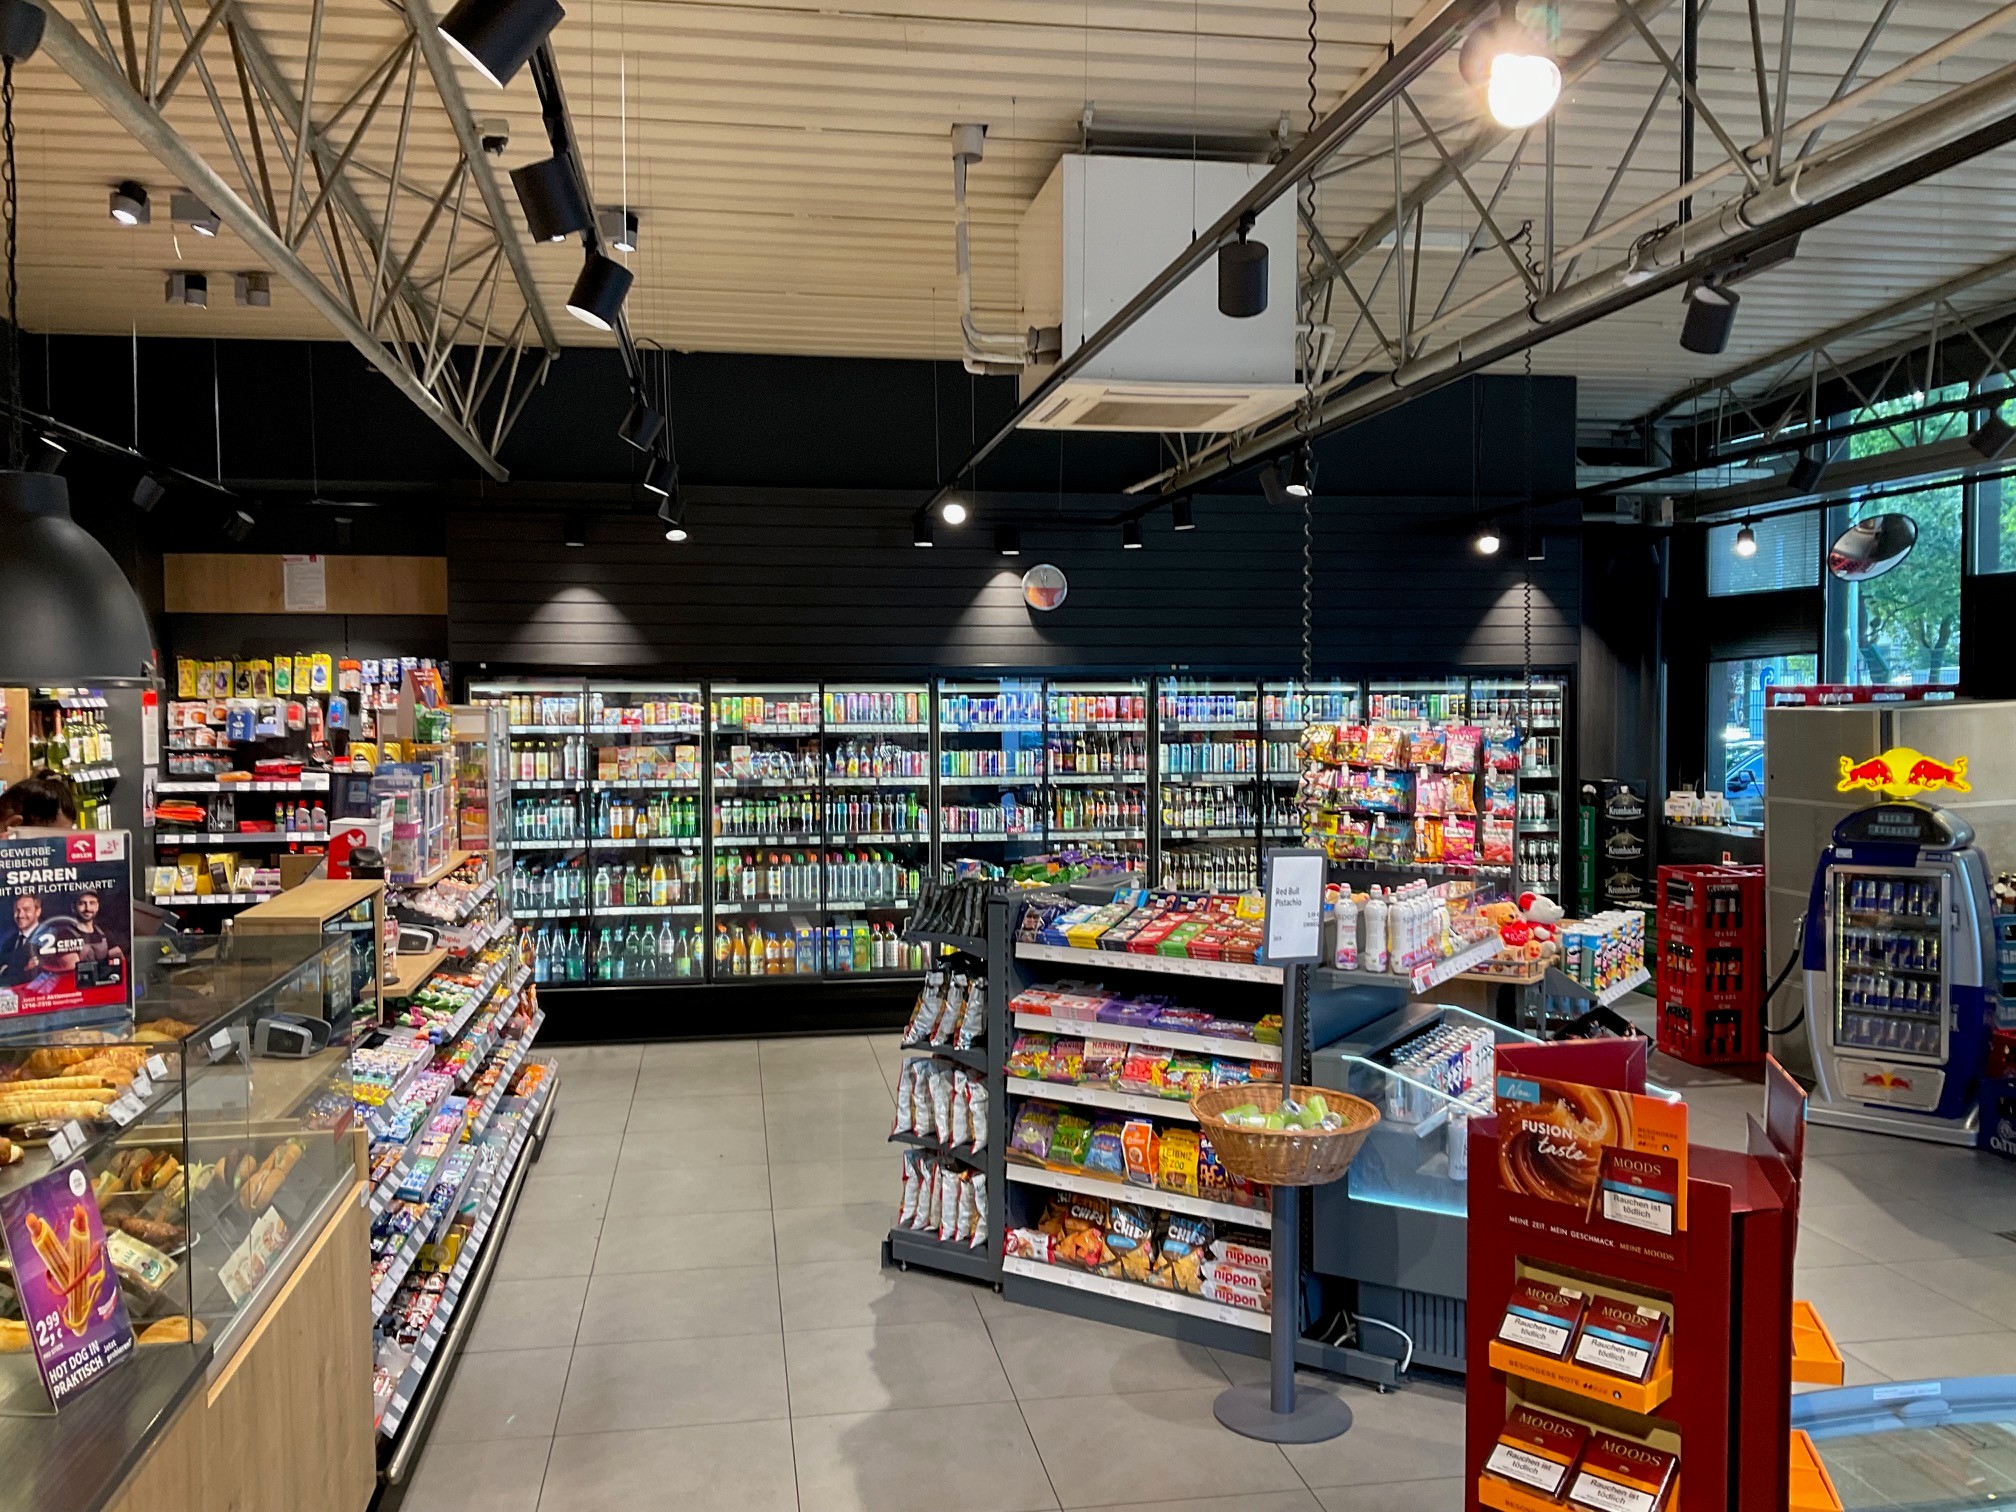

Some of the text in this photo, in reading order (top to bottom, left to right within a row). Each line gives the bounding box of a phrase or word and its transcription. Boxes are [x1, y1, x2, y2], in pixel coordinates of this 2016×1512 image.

[1608, 805, 1642, 815] Krombacher
[0, 846, 56, 858] GEWERBE-
[1608, 845, 1642, 855] Krombacher
[0, 857, 49, 869] REIBENDE
[6, 867, 78, 885] SPAREN
[0, 887, 12, 897] IT
[14, 885, 36, 896] DER
[1275, 887, 1300, 896] Red Bull
[1608, 885, 1641, 894] Krombacher
[1274, 898, 1302, 907] Pistachio
[39, 933, 84, 955] 2 CENT
[439, 934, 461, 944] duplo
[1637, 1127, 1678, 1139] BESONDERE
[1637, 1133, 1656, 1141] NOTE
[1162, 1147, 1193, 1161] LEIBNIZ
[1537, 1136, 1588, 1161] taste
[1169, 1159, 1184, 1170] ZOO
[1613, 1156, 1662, 1176] MOODS
[1613, 1193, 1662, 1212] Rauchen ist
[1623, 1205, 1651, 1218] tödlich
[1071, 1205, 1104, 1226] CHIPS
[1509, 1215, 1529, 1227] MEINE
[1550, 1225, 1568, 1236] MEIN
[1620, 1243, 1642, 1254] MEINE
[1643, 1245, 1674, 1261] MOODS
[1225, 1247, 1268, 1266] nippon
[1214, 1268, 1257, 1287] nippon
[1214, 1287, 1257, 1307] nippon
[1525, 1286, 1570, 1307] MOODS
[1601, 1305, 1649, 1327] MOODS
[1514, 1317, 1559, 1336] Rauchen ist
[1520, 1328, 1546, 1341] tödlich
[103, 1339, 117, 1354] Jetzt
[1591, 1338, 1638, 1358] Rauchen ist
[49, 1340, 100, 1383] HOT DOG IN
[1598, 1349, 1625, 1363] tödlich
[53, 1355, 104, 1399] PRAKTISCH
[1508, 1359, 1580, 1386] BESONDERE NOTE
[1518, 1412, 1575, 1439] MOODS
[1506, 1450, 1552, 1471] Rauchen ist
[1601, 1440, 1662, 1467] MOODS
[1512, 1461, 1539, 1475] tödlich
[1590, 1478, 1640, 1501] Rauchen ist
[1597, 1489, 1626, 1505] tödlich
